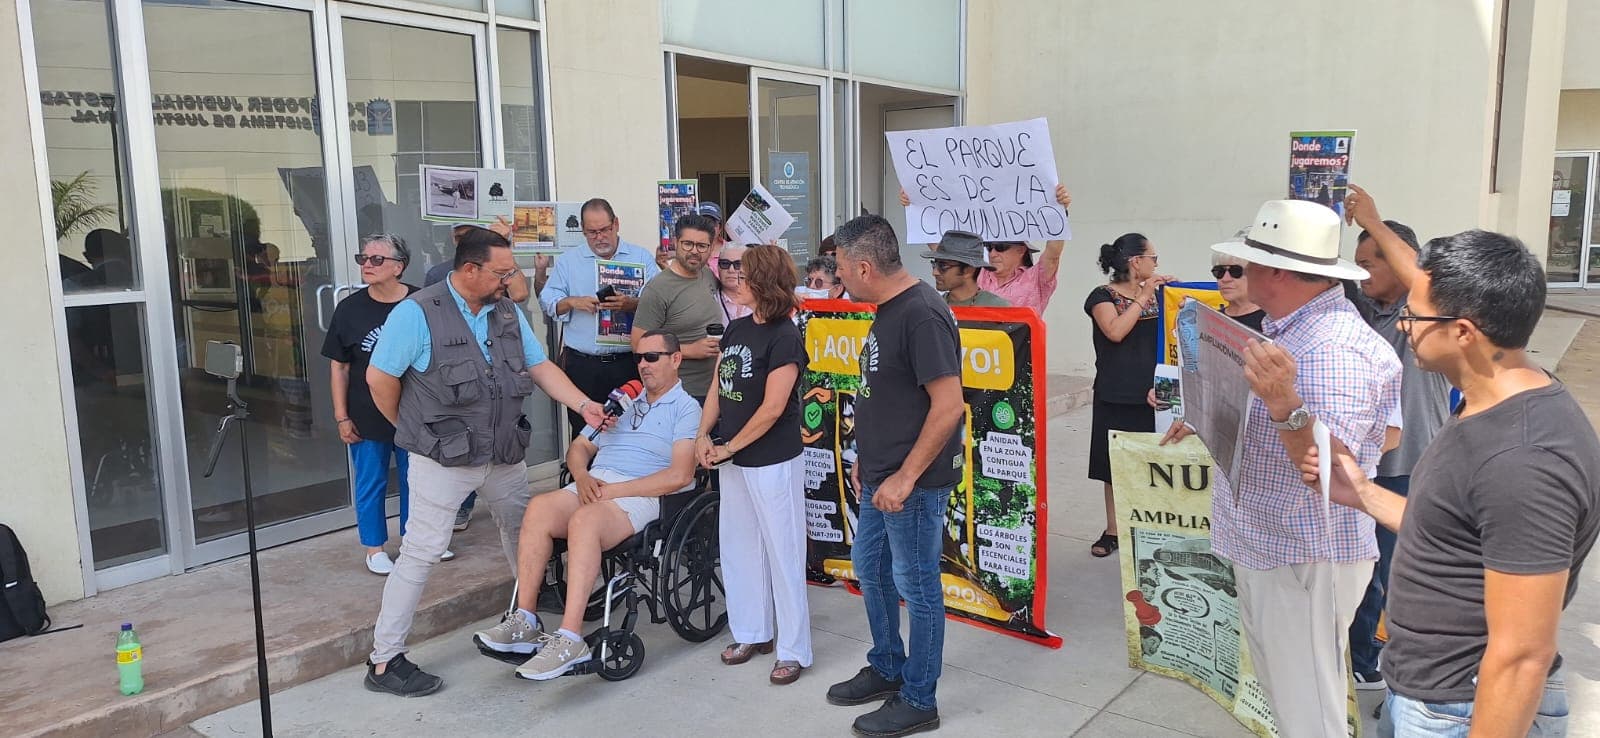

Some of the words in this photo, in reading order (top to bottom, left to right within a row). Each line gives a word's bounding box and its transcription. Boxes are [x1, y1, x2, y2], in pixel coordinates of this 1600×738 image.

[906, 138, 939, 170] EL
[945, 132, 1035, 169] PARQUE
[1292, 140, 1321, 151] Donde
[1291, 154, 1349, 168] jugaremos?
[659, 185, 679, 195] Donde
[916, 174, 951, 201] ES
[959, 174, 996, 202] DE
[1015, 174, 1048, 204] LA
[659, 195, 696, 205] jugaremos?
[921, 205, 1065, 239] COMUNIDAD
[599, 265, 624, 276] Donde
[599, 276, 643, 289] jugaremos?
[361, 325, 385, 353] SALVEM
[989, 435, 1019, 446] ANIDAN
[983, 445, 995, 454] EN
[995, 446, 1003, 455] LA
[1004, 447, 1027, 458] ZONA
[986, 456, 1025, 468] CONTIGUA
[987, 467, 996, 476] AL
[997, 468, 1028, 480] PARQUE
[979, 528, 993, 537] LOS
[995, 541, 1011, 551] SON
[981, 549, 1027, 566] ESCENCIALES
[984, 560, 1002, 570] PARA
[1003, 562, 1026, 576] ELLOS
